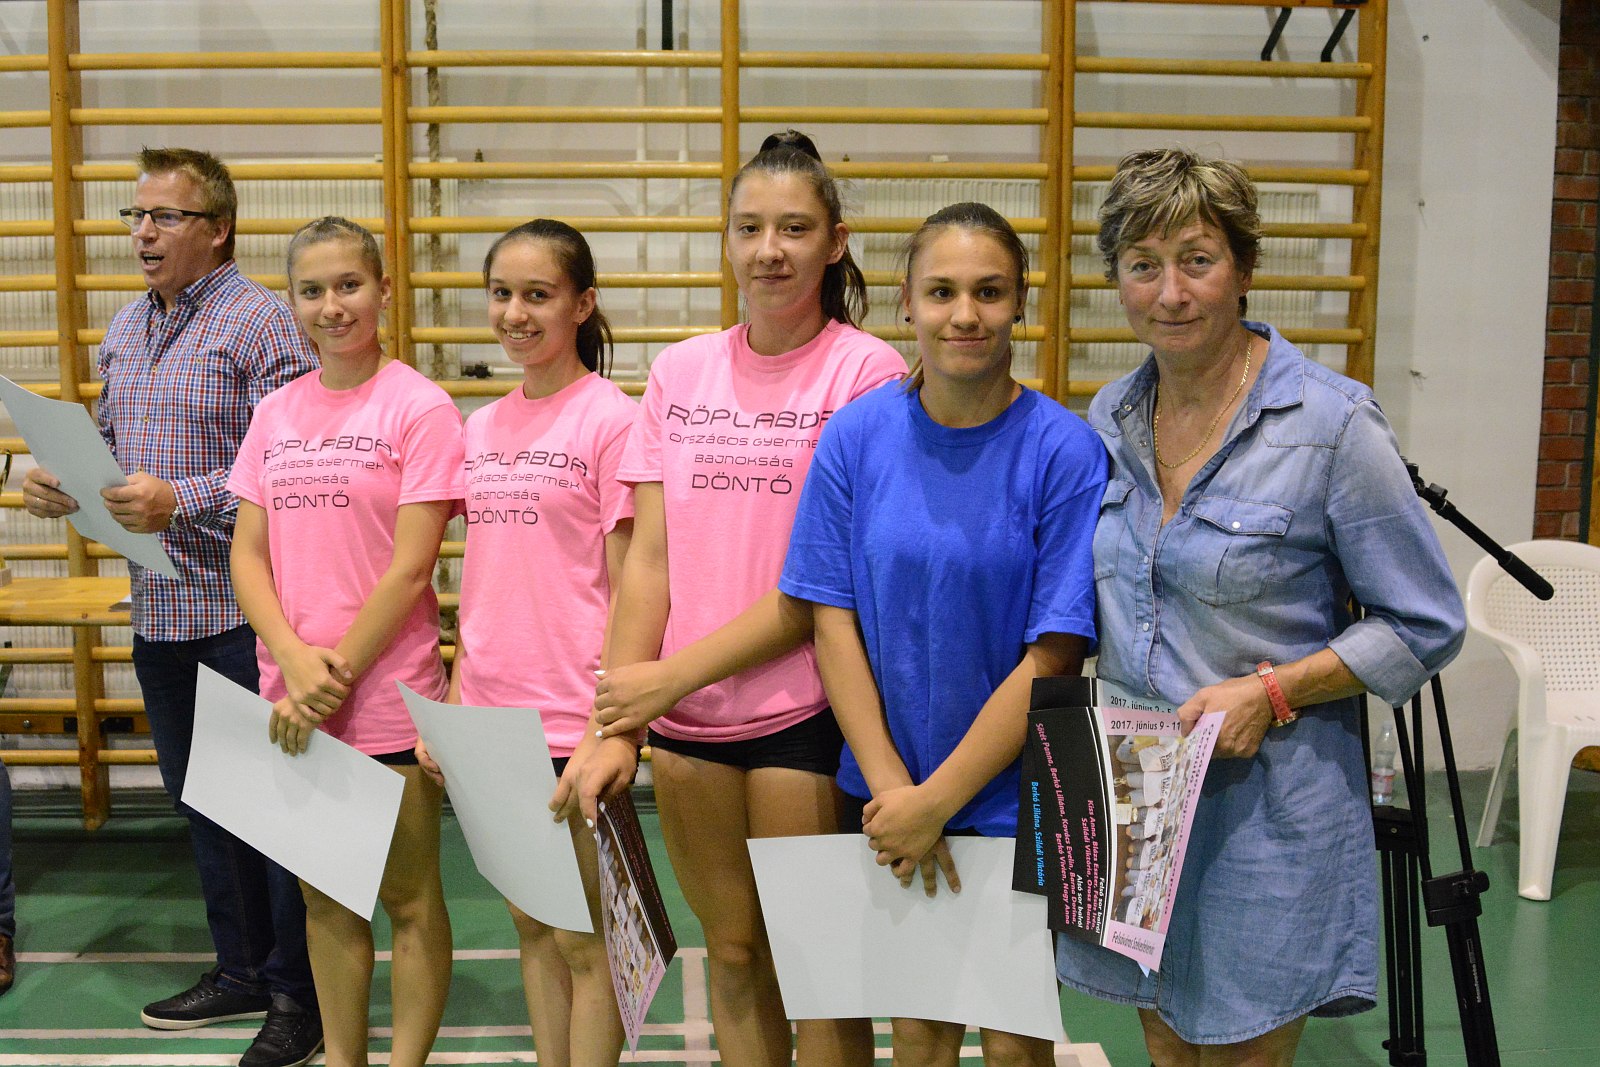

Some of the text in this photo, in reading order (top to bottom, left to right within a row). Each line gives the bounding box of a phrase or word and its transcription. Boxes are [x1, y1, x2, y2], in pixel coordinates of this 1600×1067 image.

[692, 472, 792, 494] DÖNTŐ
[273, 490, 349, 510] DÖNTŐ
[1111, 696, 1130, 708] 2017.
[1111, 721, 1133, 729] 2017.
[1135, 720, 1157, 732] június
[1159, 721, 1164, 729] 9
[1172, 722, 1180, 730] 11
[1036, 723, 1047, 741] Sötét
[1042, 742, 1054, 766] Panna,
[1050, 768, 1061, 788] Berkó
[1056, 790, 1066, 817] Liliána,
[1062, 819, 1070, 844] Kovács
[1066, 846, 1074, 870] Evelin,
[1031, 781, 1045, 886] Berkó Liliána, Sziládi Viktória
[1081, 818, 1090, 843] Sziládi
[1055, 833, 1063, 854] Berkó
[1059, 856, 1067, 881] Vivien,
